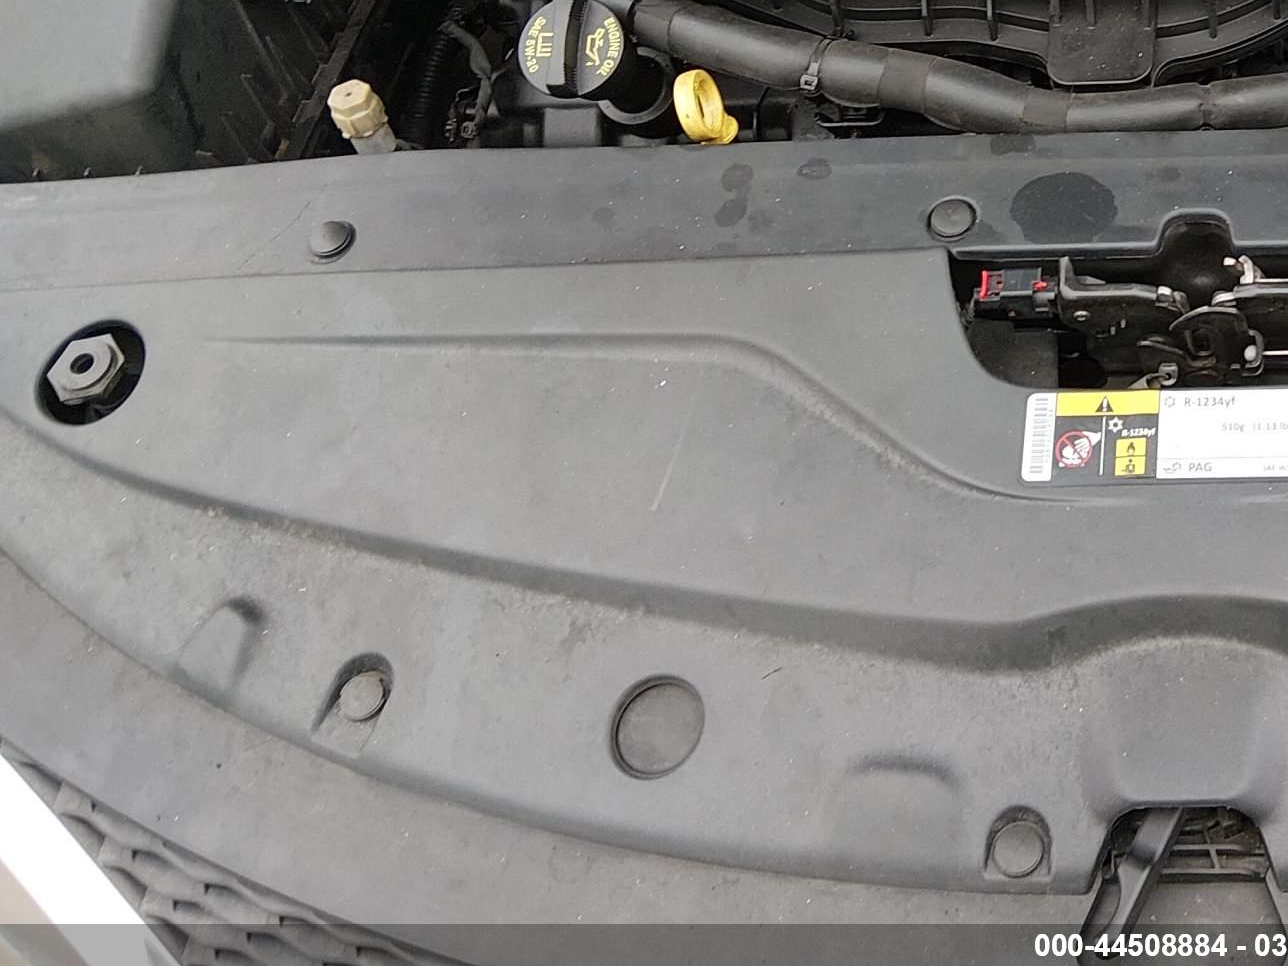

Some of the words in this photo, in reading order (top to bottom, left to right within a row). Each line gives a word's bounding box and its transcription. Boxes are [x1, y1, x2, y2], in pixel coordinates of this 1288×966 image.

[528, 16, 547, 38] SAE
[603, 17, 621, 59] ENGINE
[524, 39, 540, 74] 5W-20
[595, 59, 615, 76] OIL
[1184, 396, 1236, 410] R-1234yf
[1221, 422, 1245, 433] 510g
[1188, 462, 1213, 472] PAG
